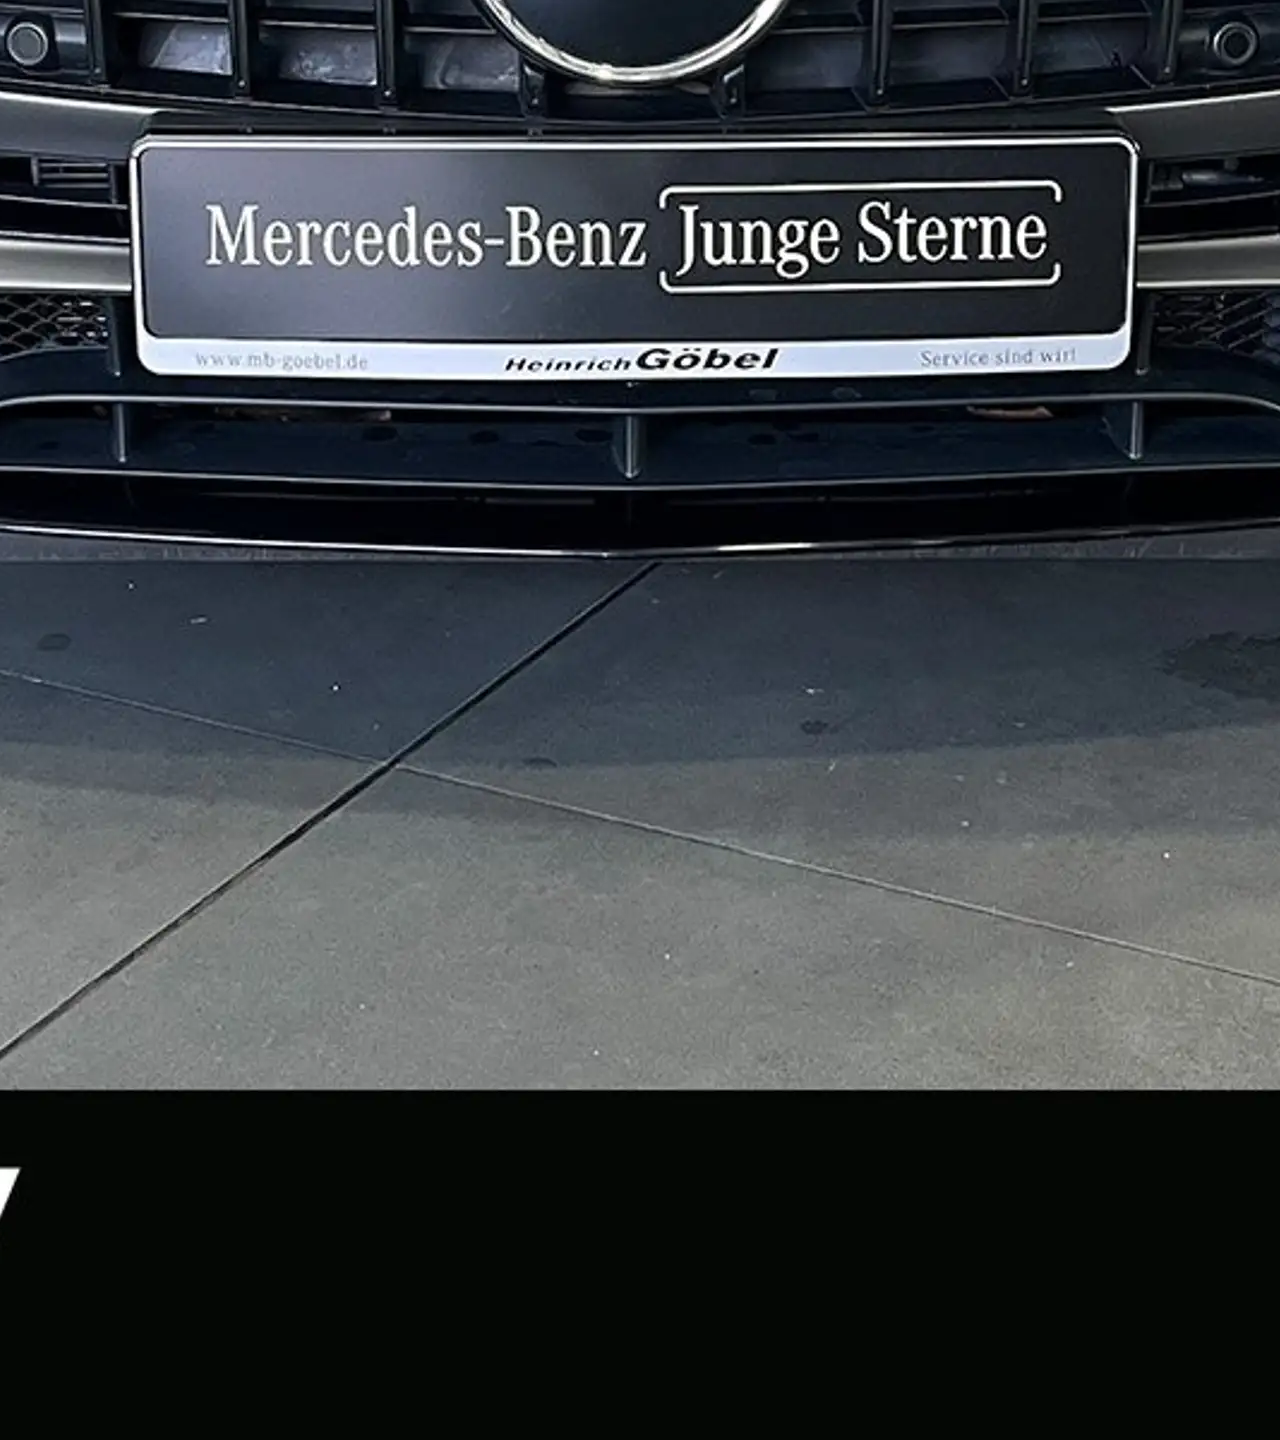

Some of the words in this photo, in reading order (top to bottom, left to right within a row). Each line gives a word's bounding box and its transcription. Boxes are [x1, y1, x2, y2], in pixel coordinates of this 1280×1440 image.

[205, 202, 647, 269] Mercedes-Benz
[674, 204, 841, 279] Junge
[857, 200, 1049, 264] Sterne
[195, 351, 368, 372] www.mb-goebel.de
[919, 349, 989, 367] Service
[995, 348, 1032, 365] sind
[1040, 347, 1076, 364] wir!
